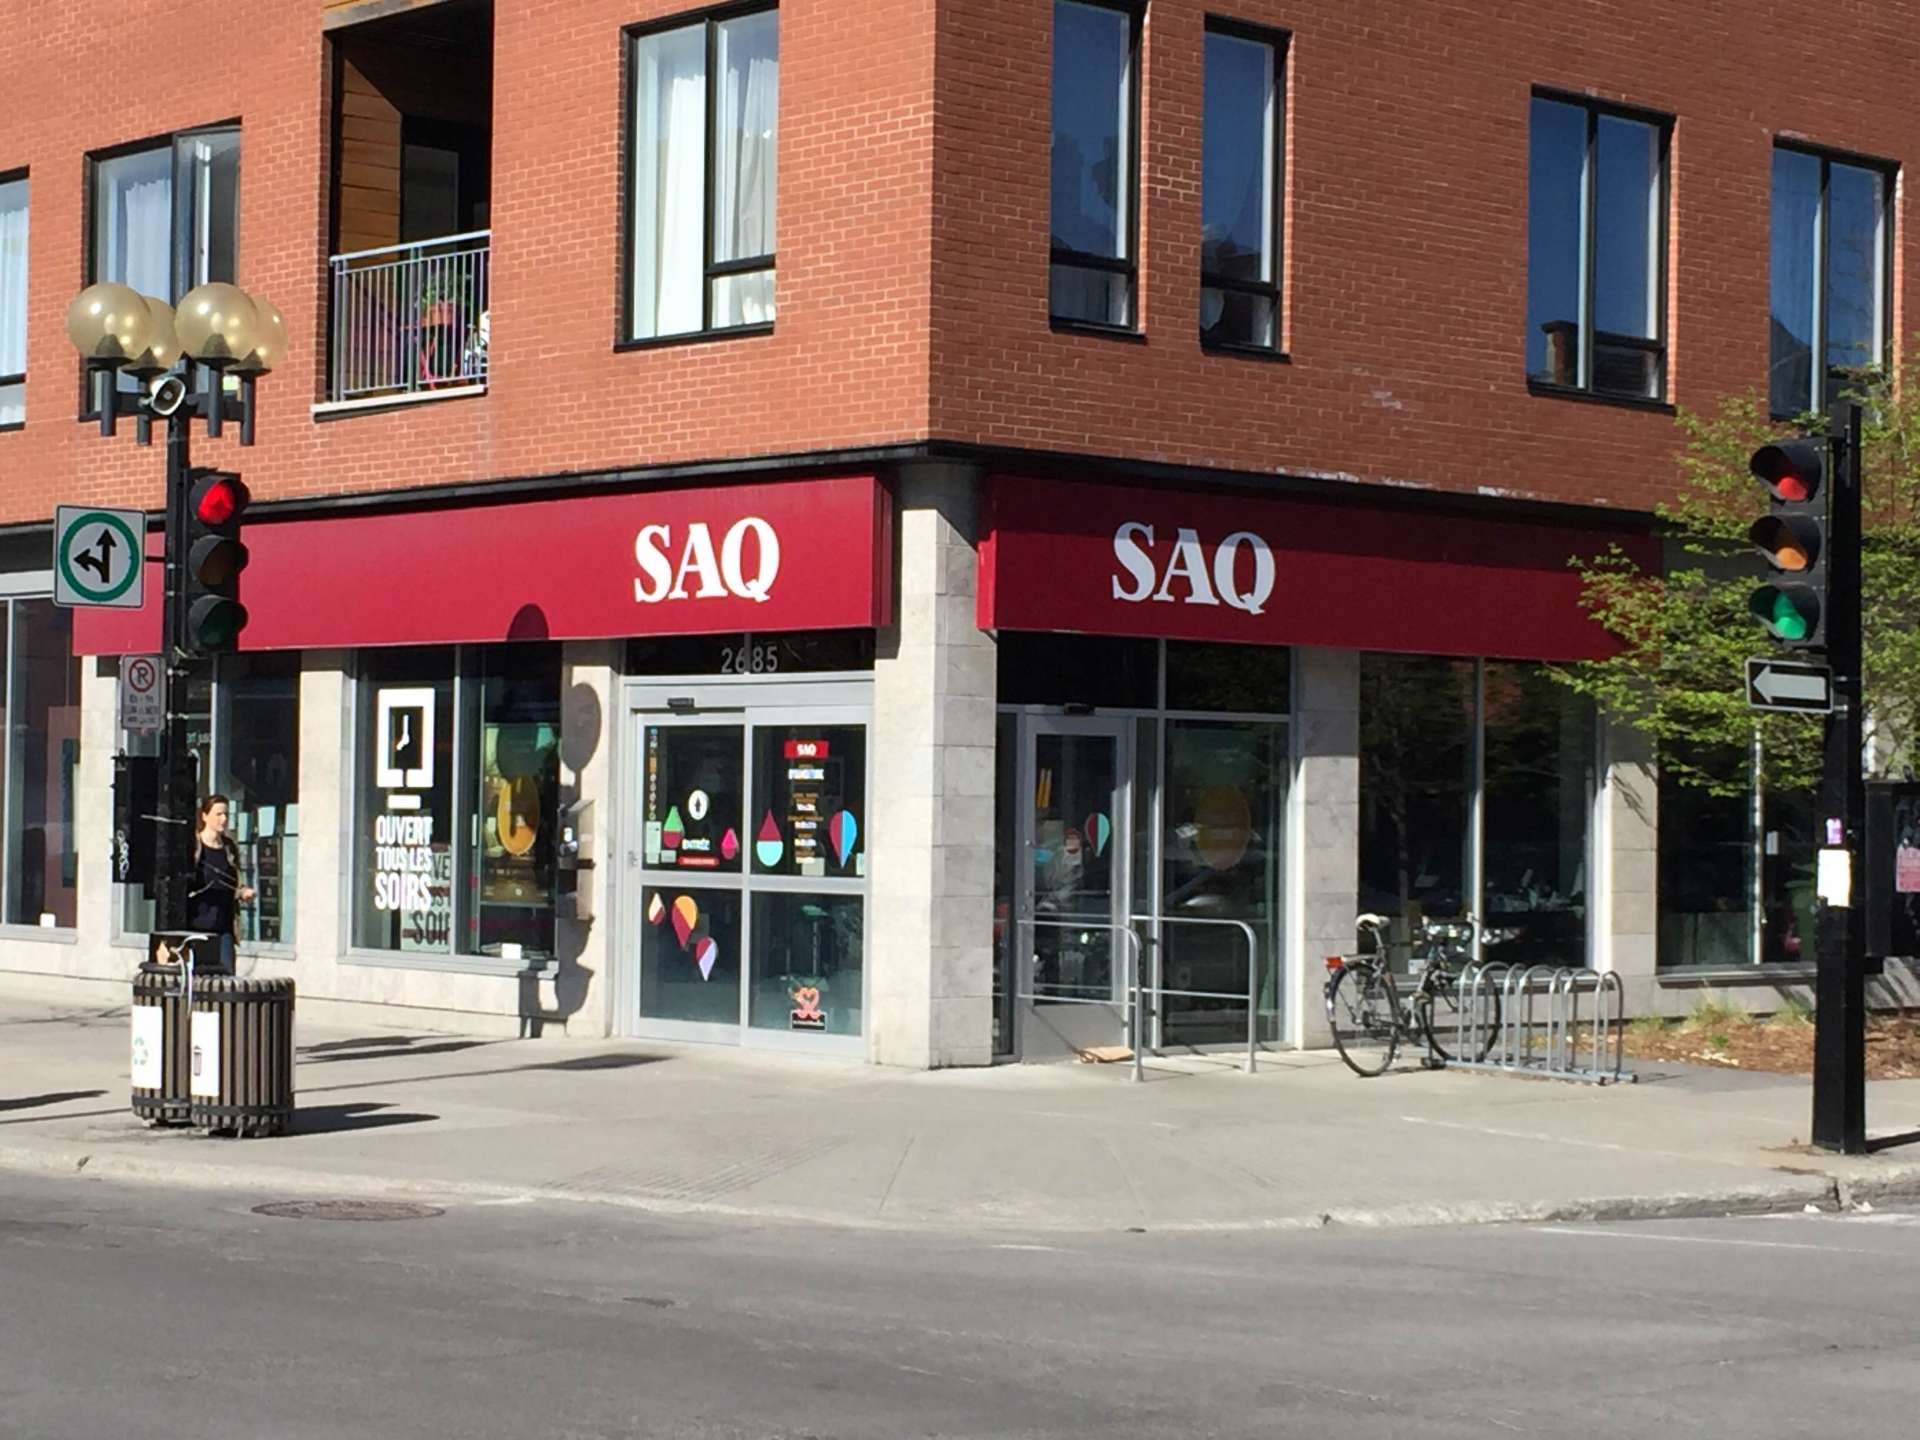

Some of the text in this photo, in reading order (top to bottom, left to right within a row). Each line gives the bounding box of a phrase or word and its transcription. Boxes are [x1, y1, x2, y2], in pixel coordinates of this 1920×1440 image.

[634, 516, 780, 603] SAQ
[1112, 521, 1276, 615] SAQ
[721, 645, 778, 673] 2685
[375, 815, 434, 845] OUVERT
[376, 846, 407, 872] TOUS
[408, 847, 433, 872] LES
[374, 872, 433, 911] SOIRS
